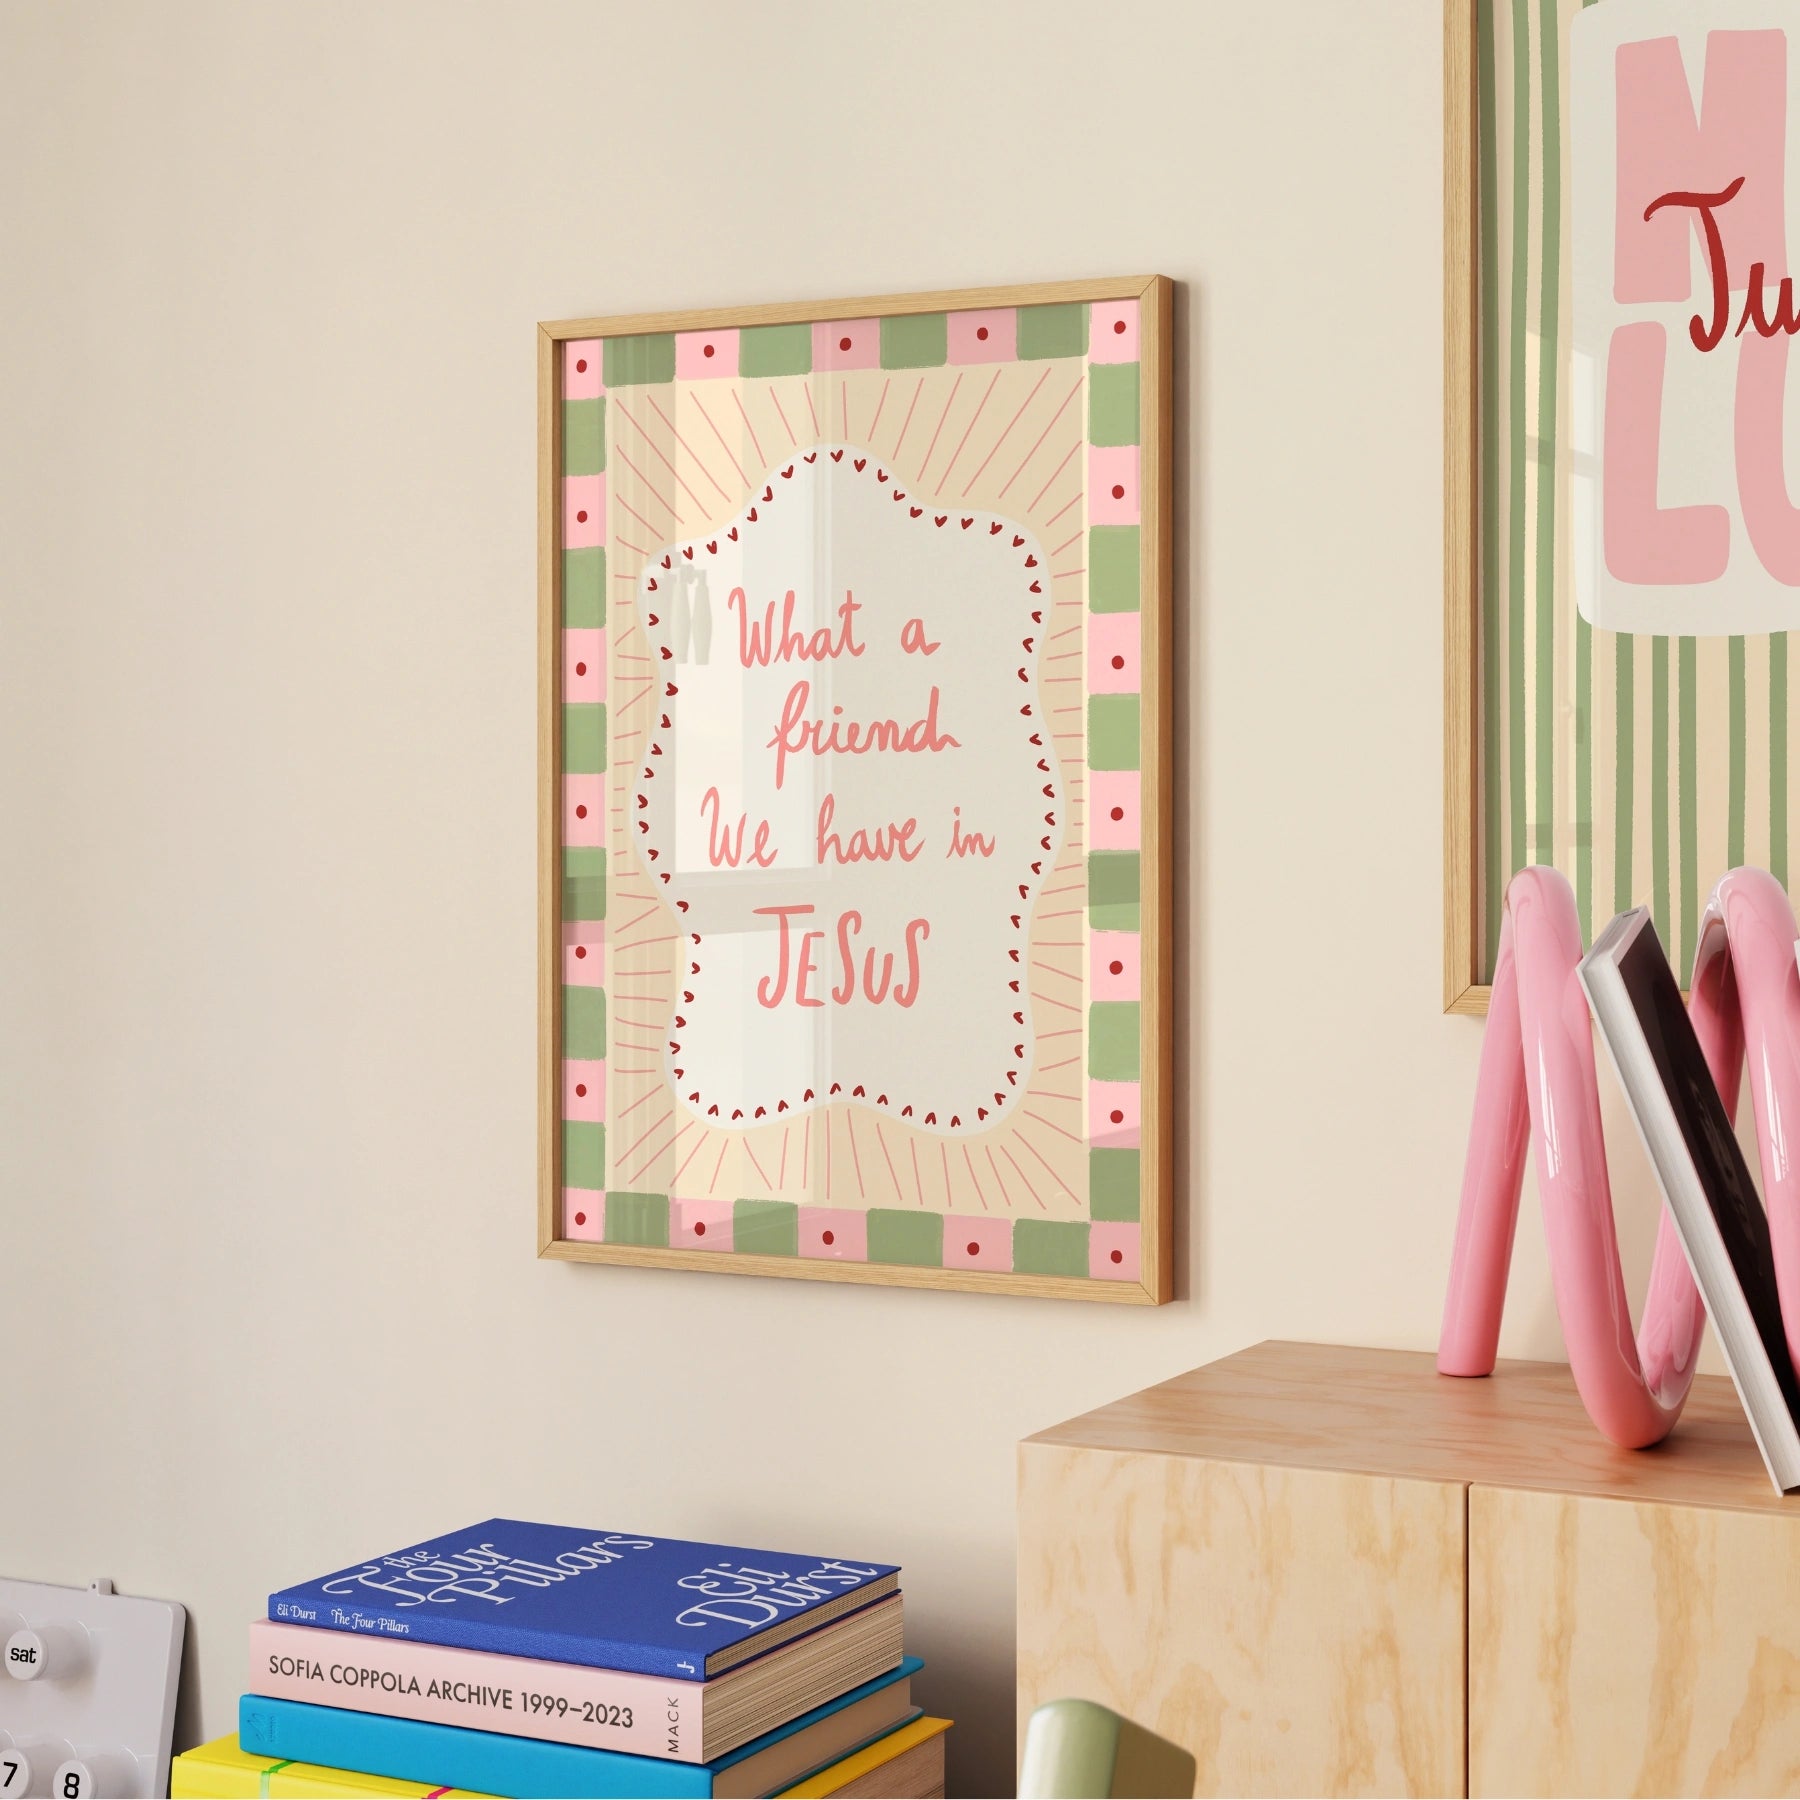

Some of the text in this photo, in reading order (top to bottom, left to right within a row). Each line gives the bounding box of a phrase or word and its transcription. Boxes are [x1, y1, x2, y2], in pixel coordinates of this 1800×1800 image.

[728, 587, 941, 668] What a
[766, 681, 962, 790] friend
[701, 787, 996, 867] We have in
[322, 1543, 511, 1607] Four
[384, 1550, 440, 1569] the
[426, 1535, 654, 1605] Pillars
[677, 1563, 790, 1597] Eli
[276, 1604, 316, 1620] Eli Durst
[331, 1608, 410, 1634] The Four Pillars
[675, 1562, 878, 1629] Durst
[10, 1647, 37, 1664] sat
[269, 1655, 325, 1682] SOFIA
[330, 1664, 421, 1697] COPPOLA
[426, 1679, 513, 1710] ARCHIVE
[668, 1697, 679, 1753] MACK
[3, 1761, 80, 1800] 7 8
